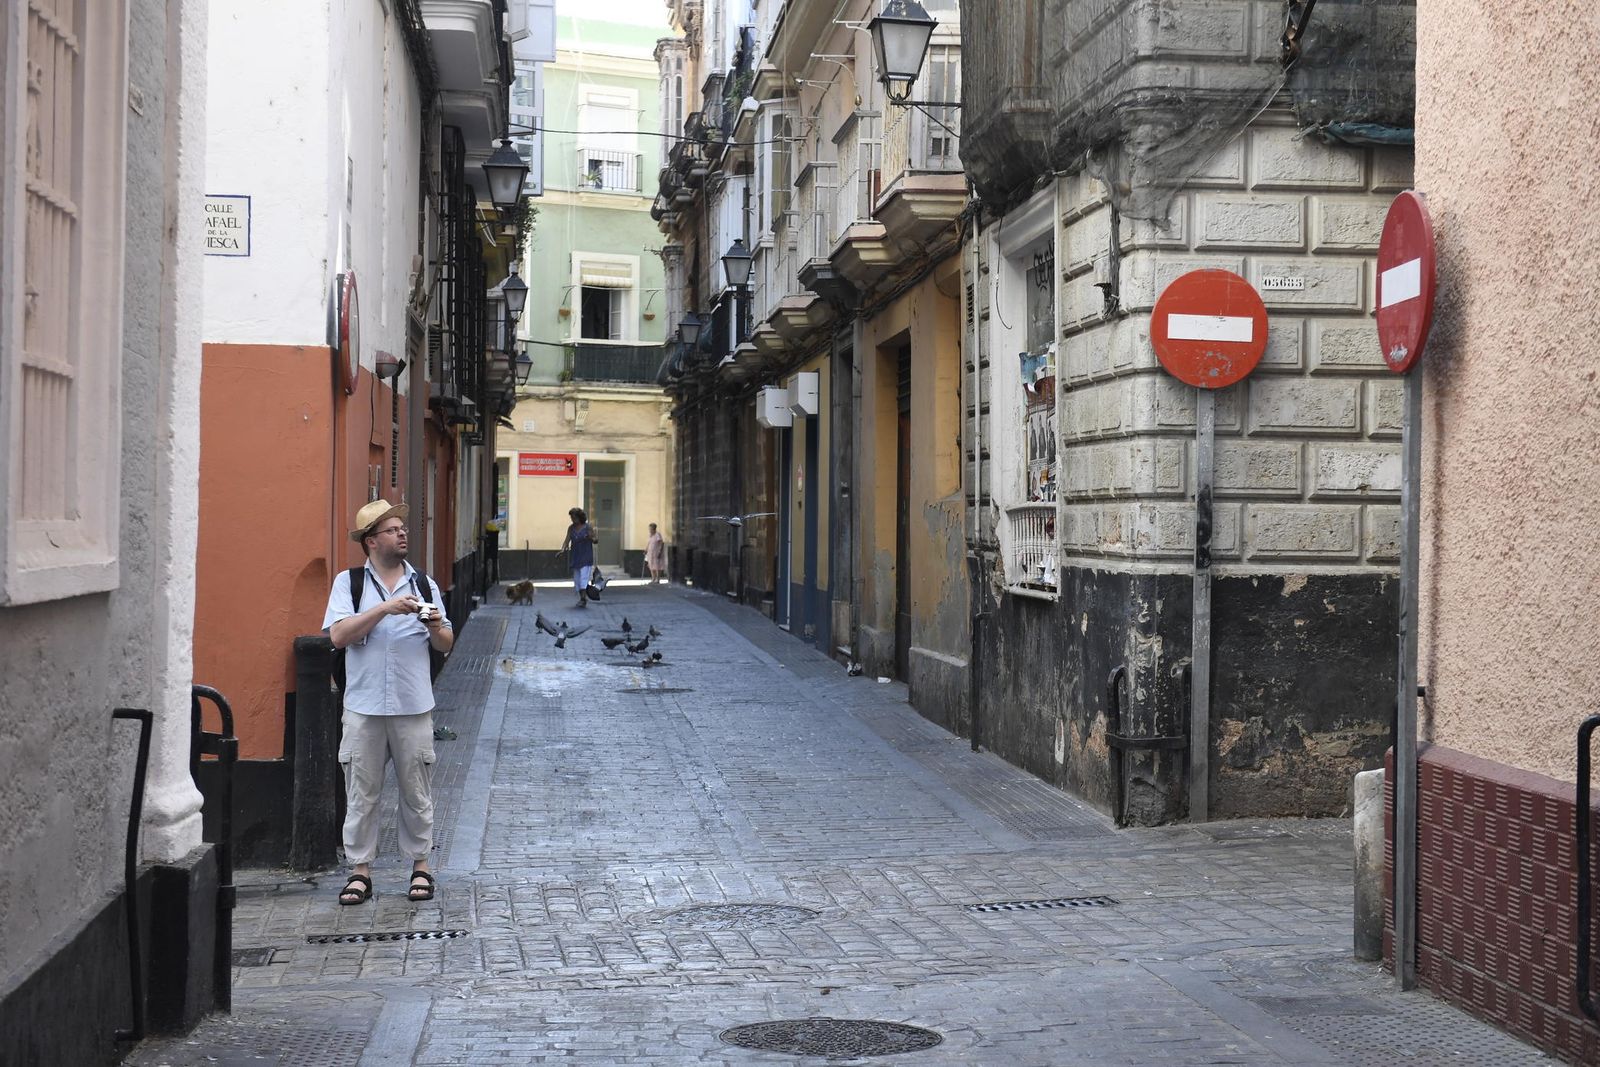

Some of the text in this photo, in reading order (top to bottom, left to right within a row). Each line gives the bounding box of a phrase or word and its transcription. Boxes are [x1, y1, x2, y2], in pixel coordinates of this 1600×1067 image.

[205, 204, 233, 213] CALLE
[205, 217, 242, 228] AFAEL
[1264, 279, 1302, 287] 05685
